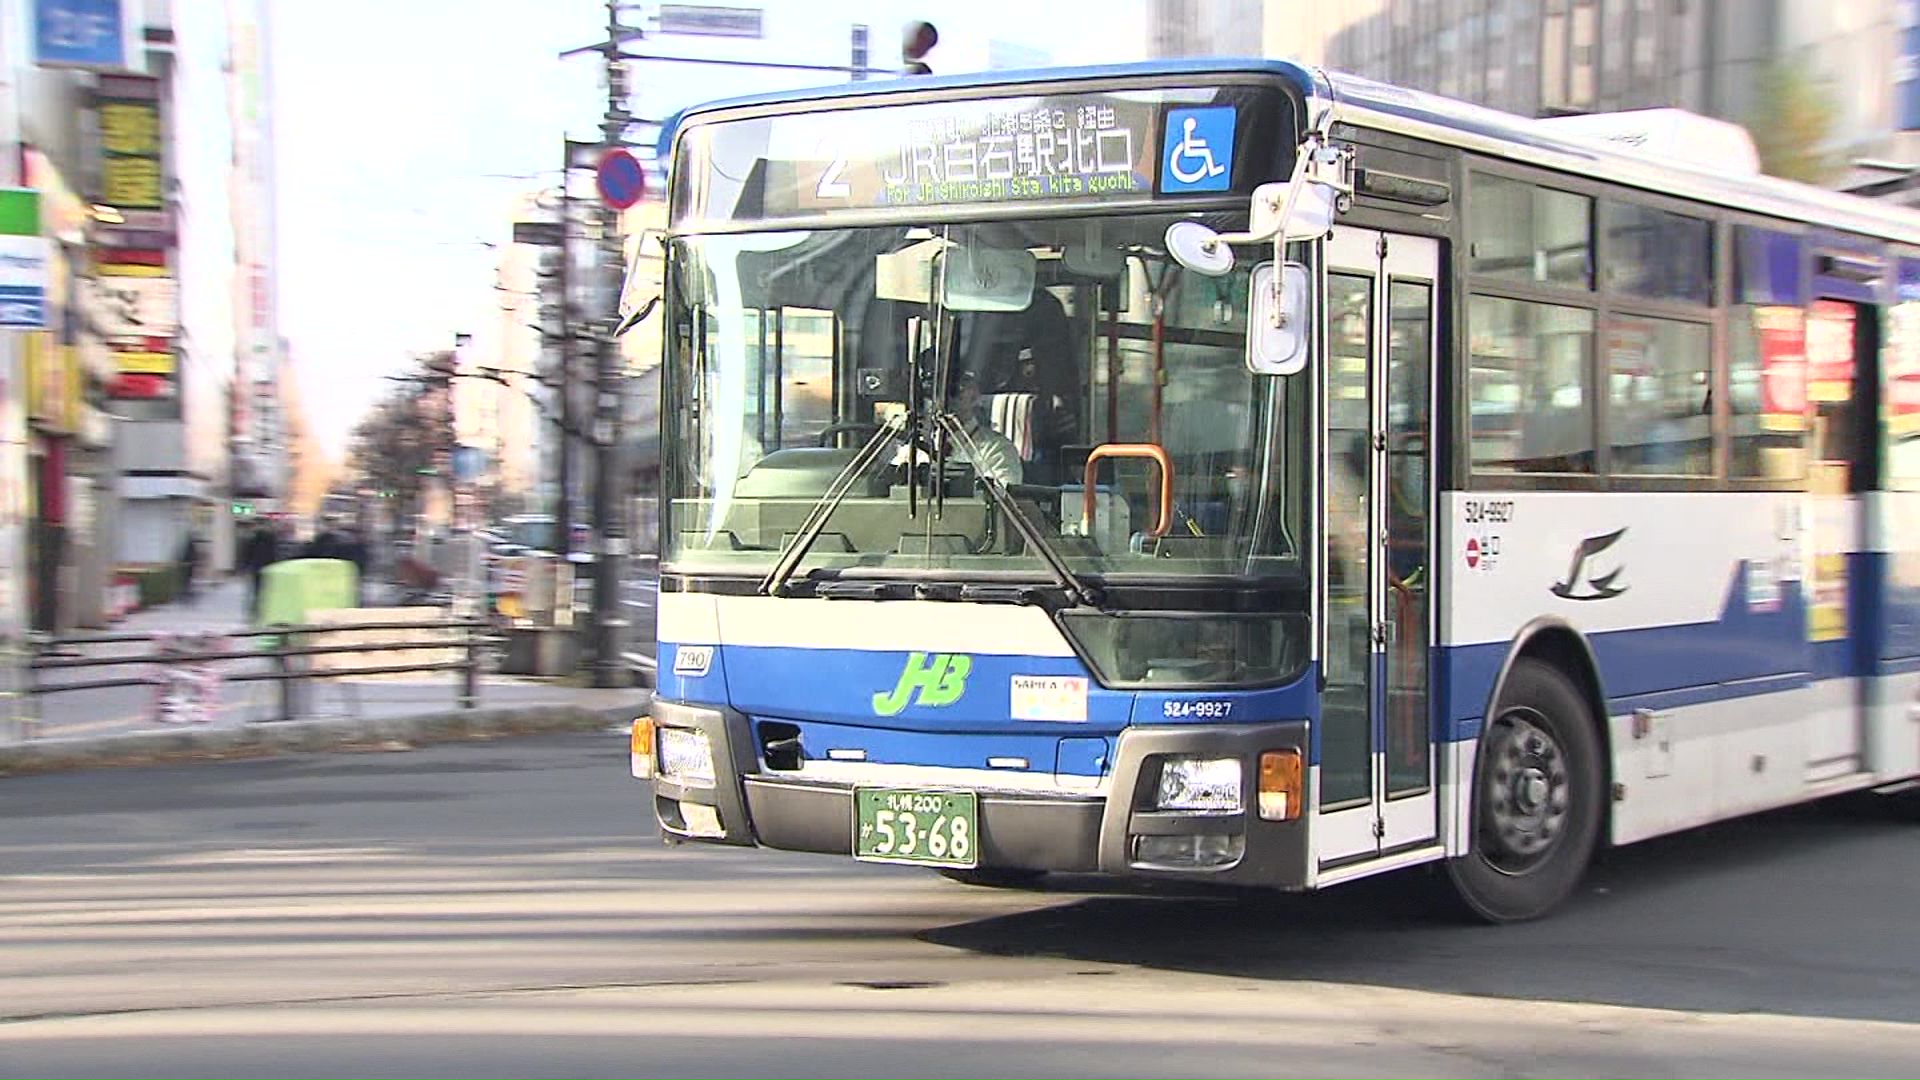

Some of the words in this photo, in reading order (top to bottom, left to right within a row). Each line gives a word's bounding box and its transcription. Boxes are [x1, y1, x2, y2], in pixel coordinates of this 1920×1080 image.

[816, 134, 852, 198] 2
[884, 127, 1132, 184] JR白石駅北口
[1465, 501, 1514, 523] 524-9927
[680, 652, 705, 667] 790
[1163, 701, 1231, 717] 524-9927
[876, 810, 969, 858] 53-68
